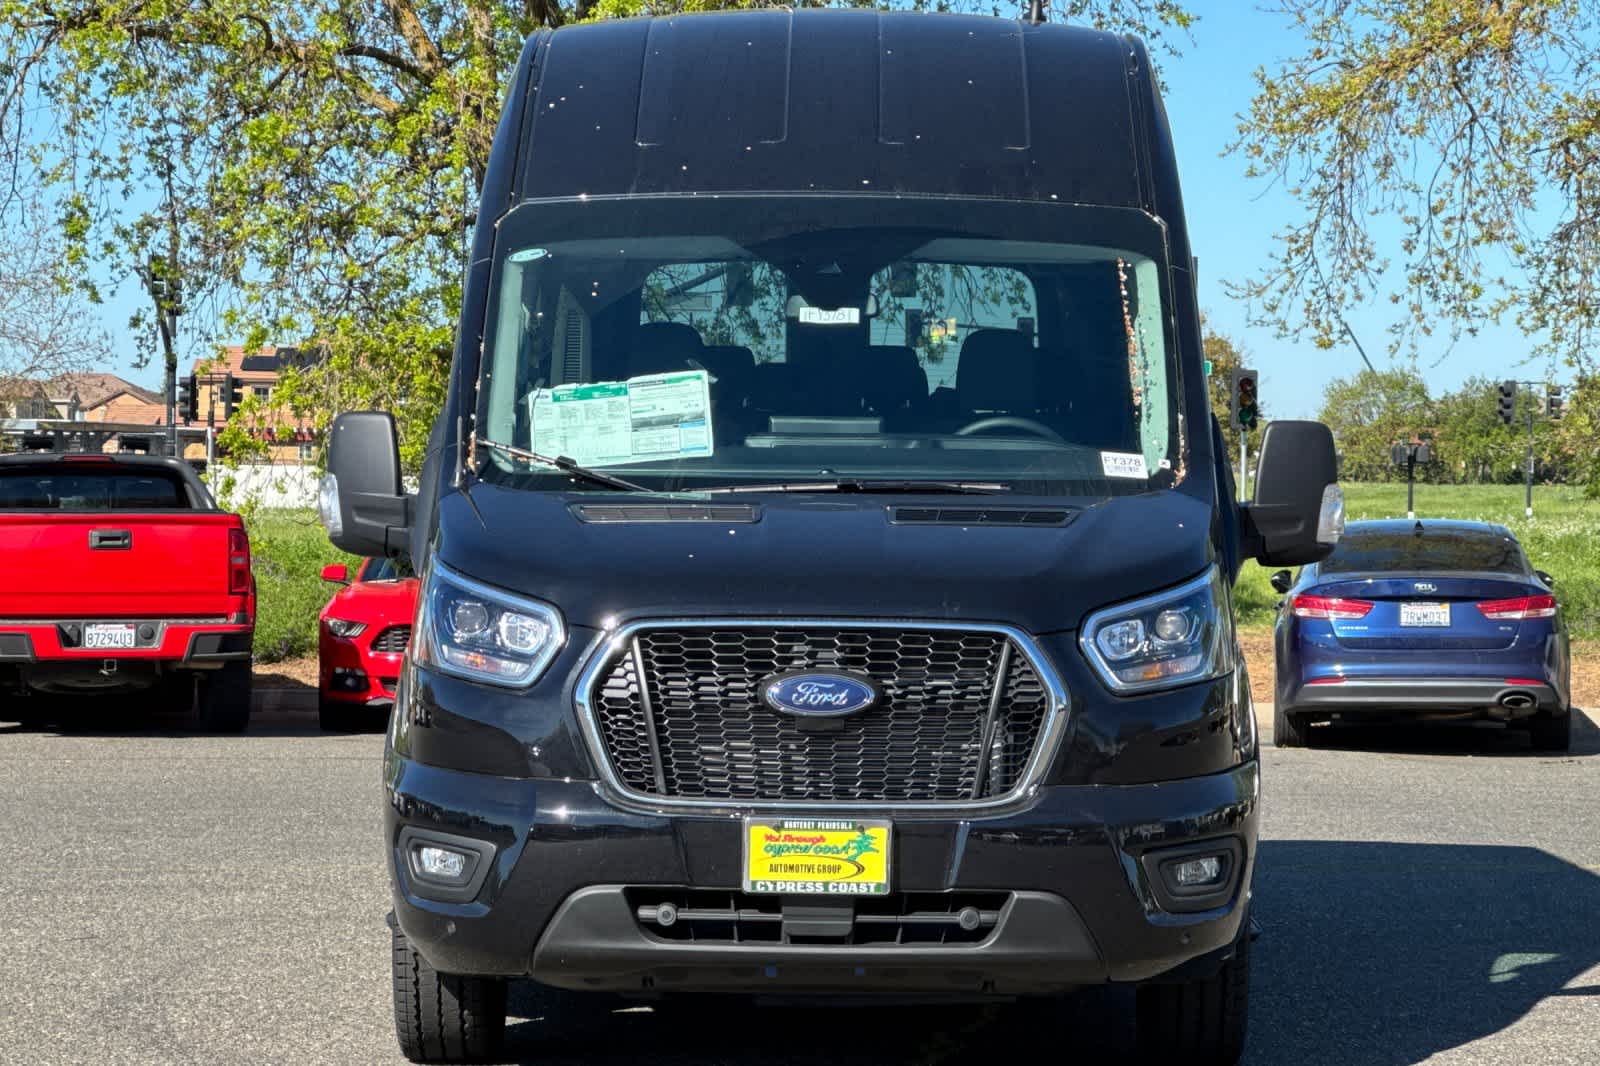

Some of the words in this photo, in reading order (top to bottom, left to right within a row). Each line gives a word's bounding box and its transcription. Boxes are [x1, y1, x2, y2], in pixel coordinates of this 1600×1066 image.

[1103, 456, 1142, 467] FY378
[87, 632, 133, 645] 87294U3
[792, 681, 848, 705] Ford
[817, 821, 853, 830] PENINSULA
[769, 863, 815, 873] AUTOMOTIVE
[817, 864, 842, 874] GROUP
[755, 880, 825, 893] CYPRESS
[828, 881, 876, 893] COAST
